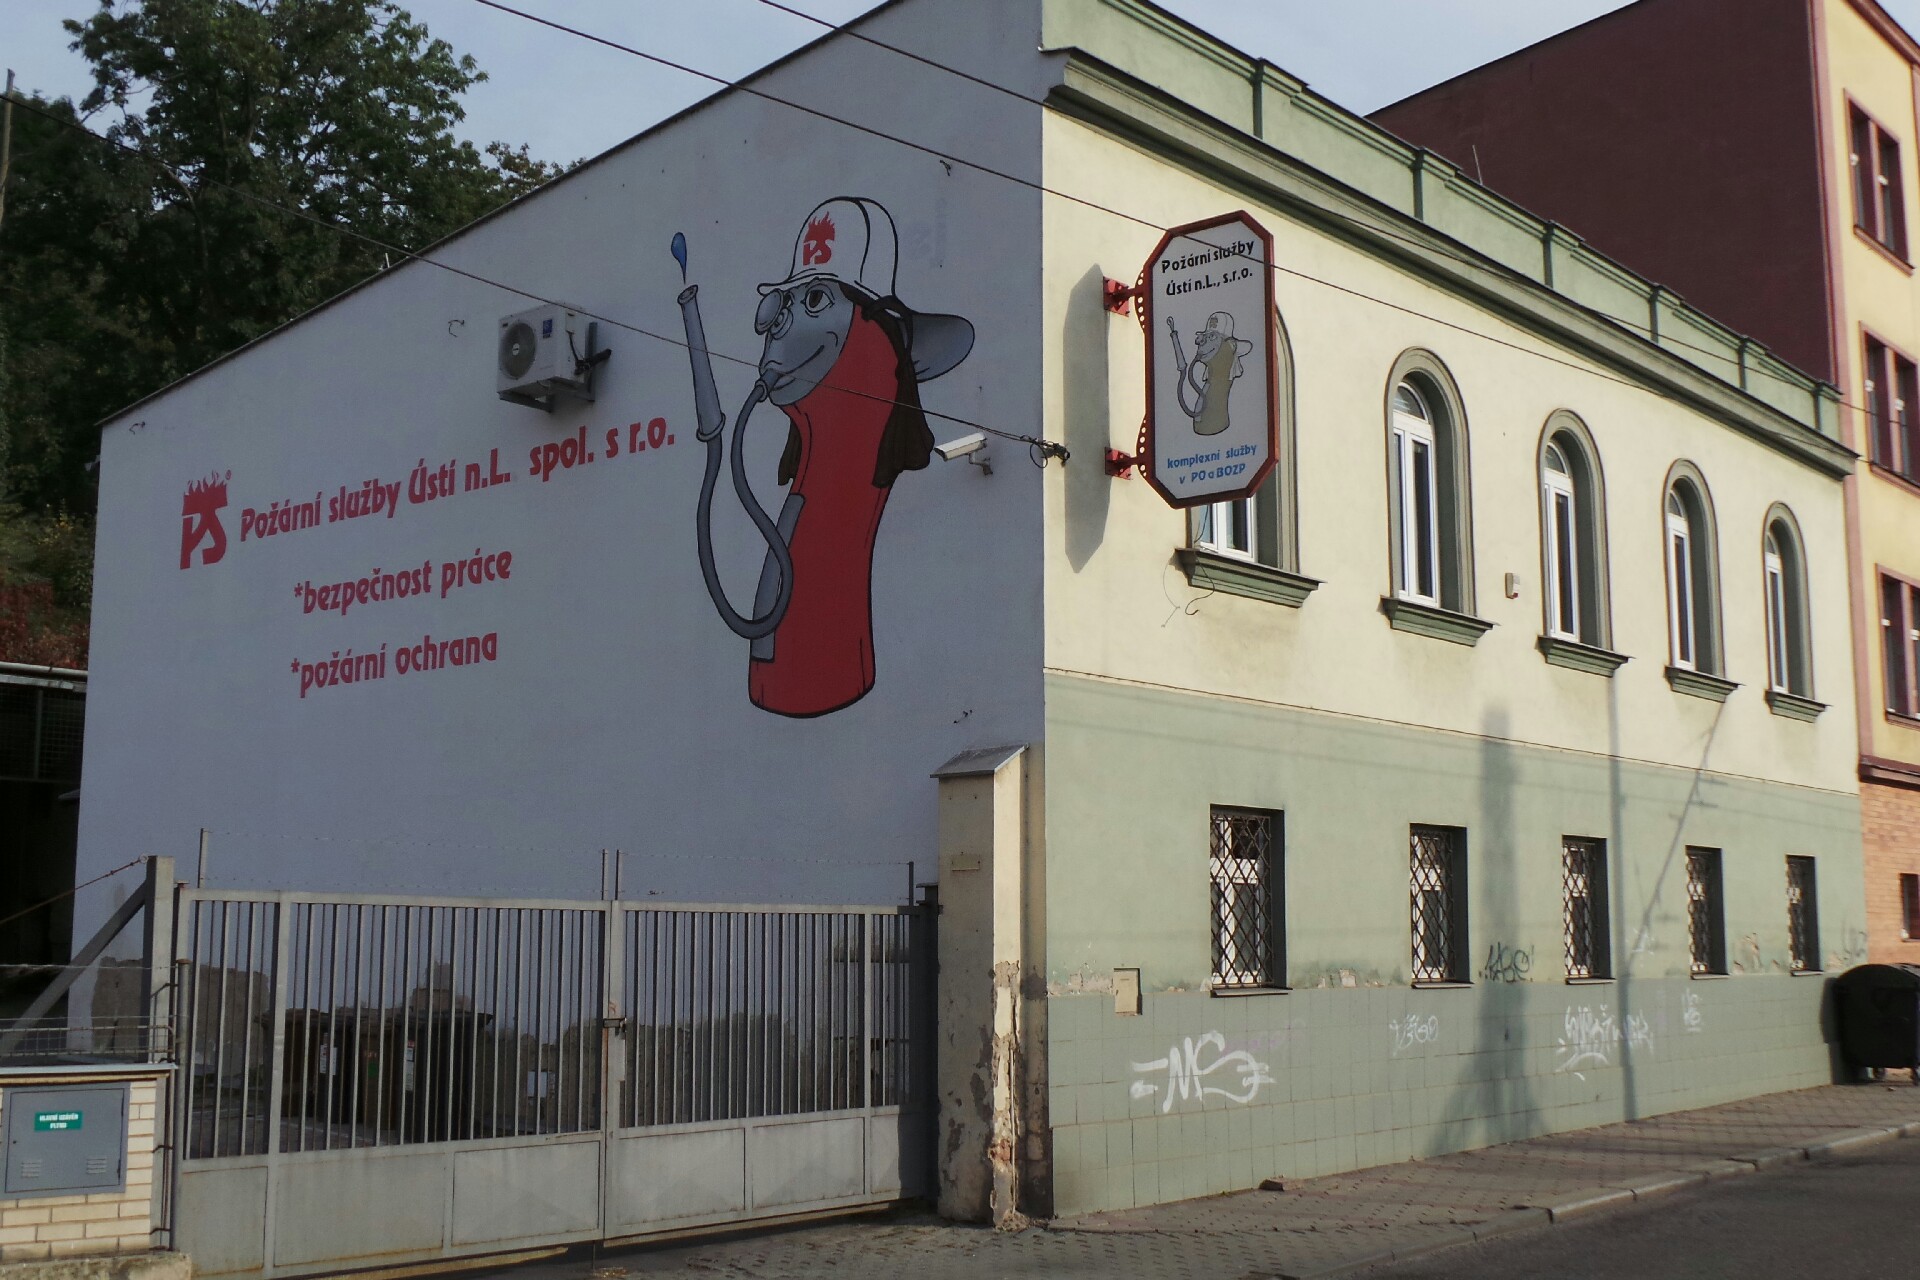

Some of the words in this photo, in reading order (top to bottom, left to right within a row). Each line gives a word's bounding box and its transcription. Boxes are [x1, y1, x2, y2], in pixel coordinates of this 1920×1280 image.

[1161, 249, 1211, 274] Požární
[1213, 240, 1255, 260] služby
[1166, 279, 1192, 296] Ústí
[1194, 274, 1221, 293] n.L.,
[1222, 267, 1253, 284] s.r.o.
[1166, 449, 1221, 469] komplexní
[1225, 444, 1257, 459] služby
[239, 490, 322, 542] Požární
[328, 478, 401, 522] služby
[408, 458, 456, 504] Ústí
[465, 448, 511, 490] n.L.
[529, 426, 595, 483] spol.
[606, 427, 619, 459] s
[628, 416, 675, 454] r.o.
[1179, 475, 1186, 485] v
[1191, 470, 1206, 483] PO
[1208, 471, 1214, 479] a
[1216, 463, 1246, 478] BOZP
[440, 547, 513, 599] práce
[395, 632, 498, 676] ochrana
